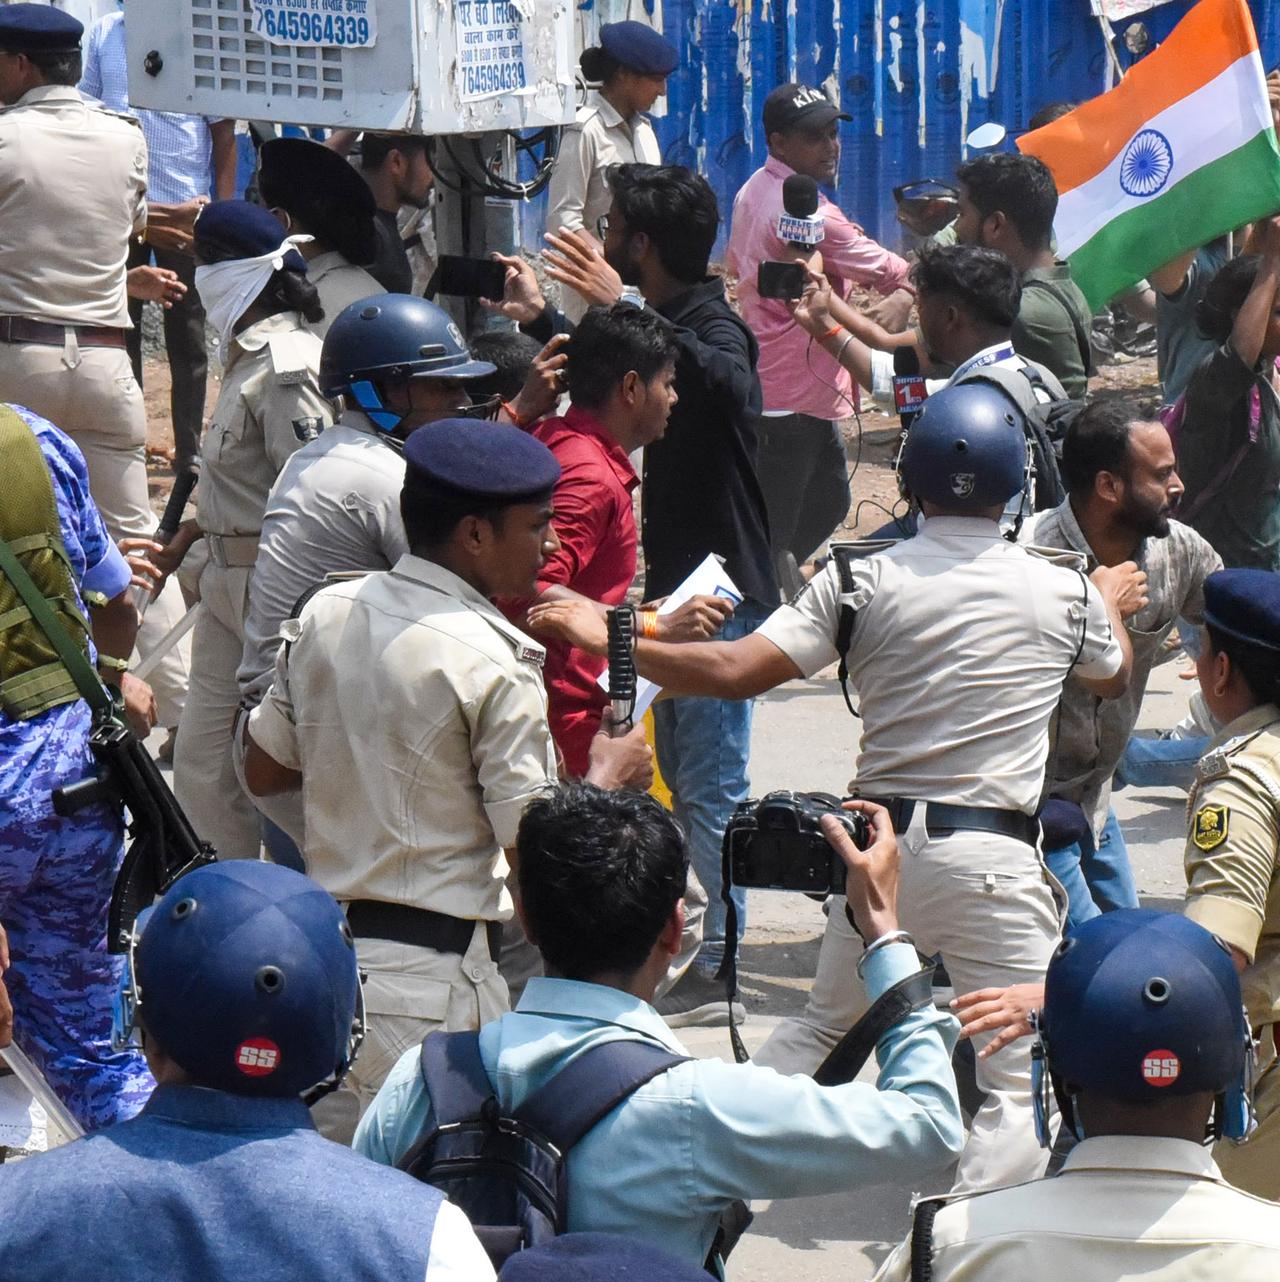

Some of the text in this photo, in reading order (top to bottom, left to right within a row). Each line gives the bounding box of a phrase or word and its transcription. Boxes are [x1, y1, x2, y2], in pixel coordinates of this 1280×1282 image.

[256, 6, 369, 45] 7645964339
[486, 29, 503, 42] काम
[462, 61, 526, 95] 7645964339
[780, 216, 811, 228] PUBLIC
[968, 353, 996, 370] RESS
[238, 1046, 277, 1068] SS
[1143, 1058, 1179, 1078] SS
